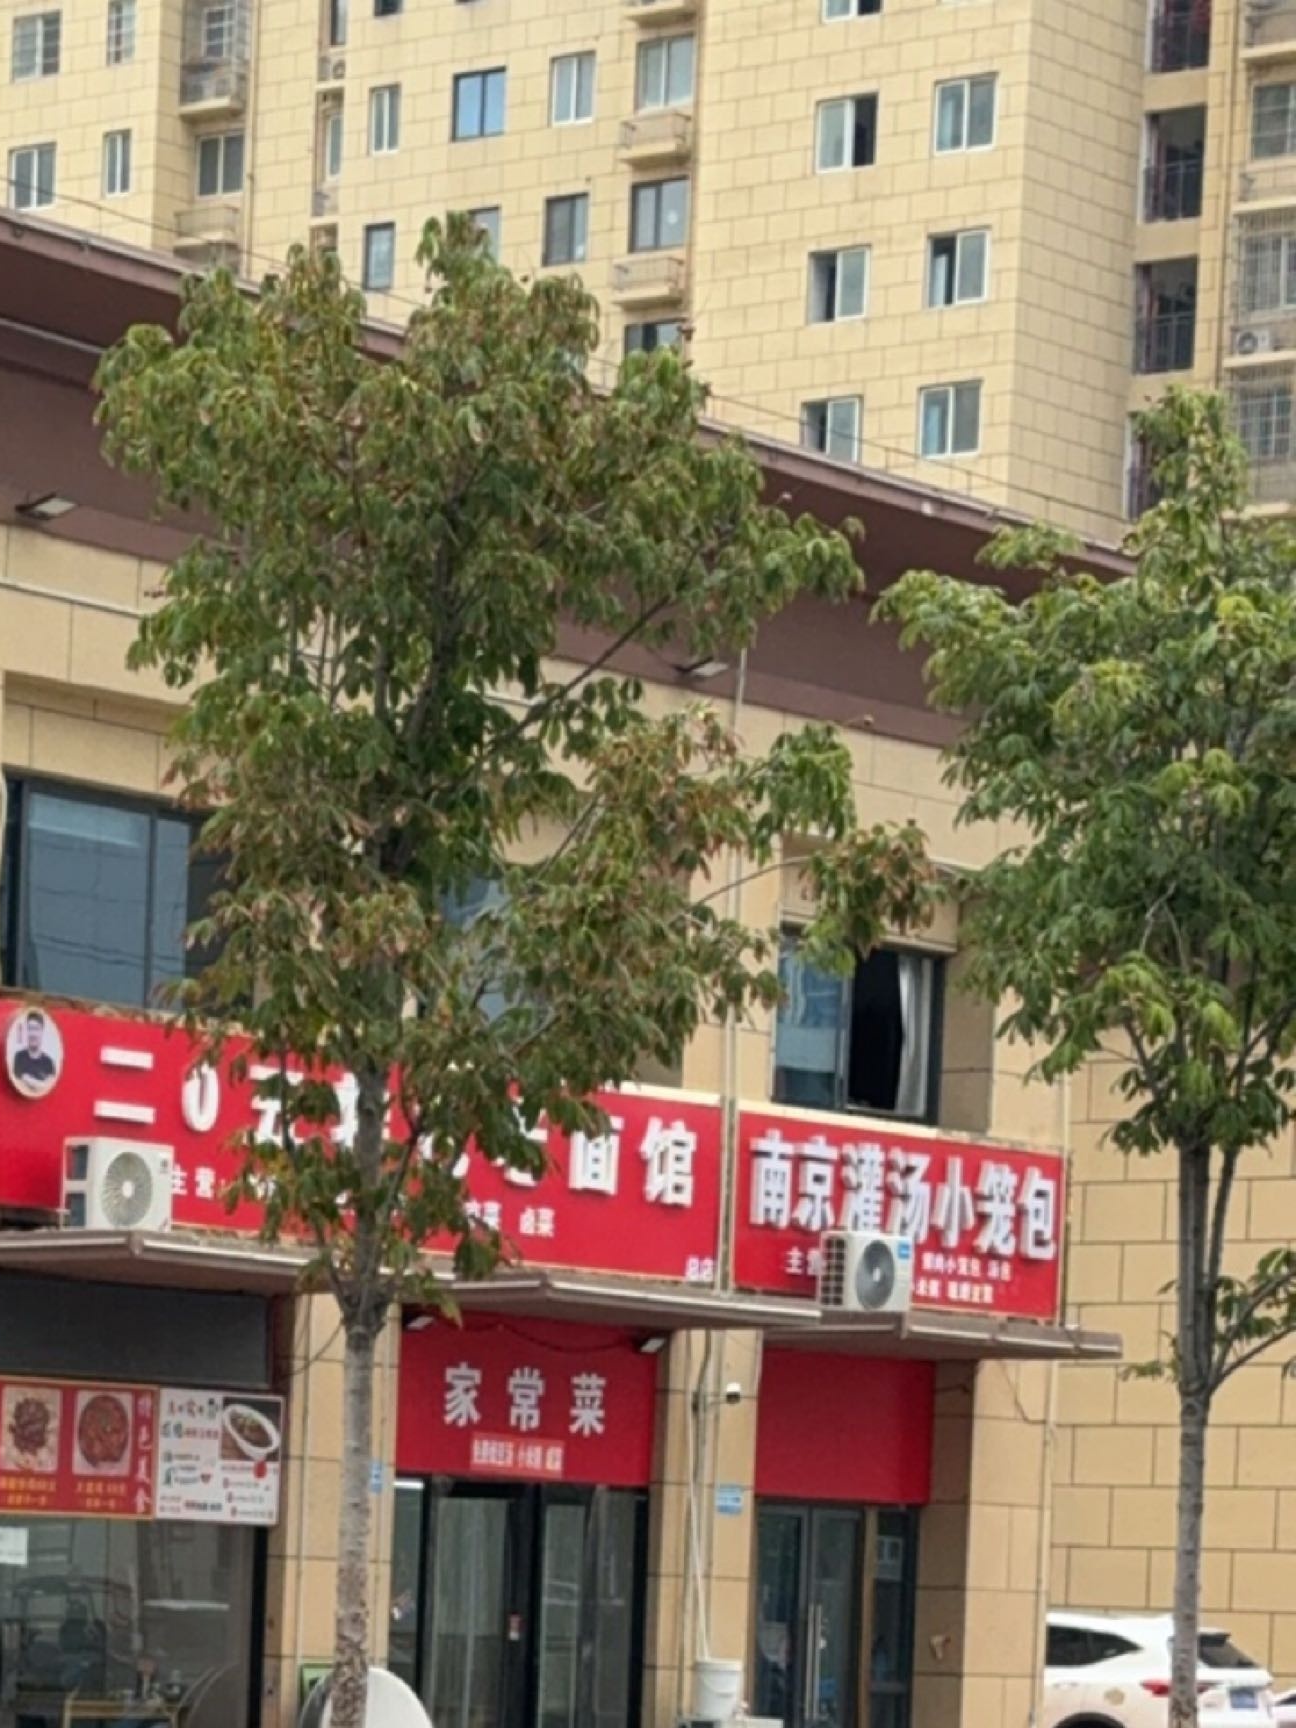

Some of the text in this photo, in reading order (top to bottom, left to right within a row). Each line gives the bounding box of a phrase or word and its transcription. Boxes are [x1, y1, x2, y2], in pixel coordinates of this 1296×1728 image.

[749, 1128, 1057, 1262] 南京灌汤小笼包
[443, 1361, 606, 1437] 家常菜
